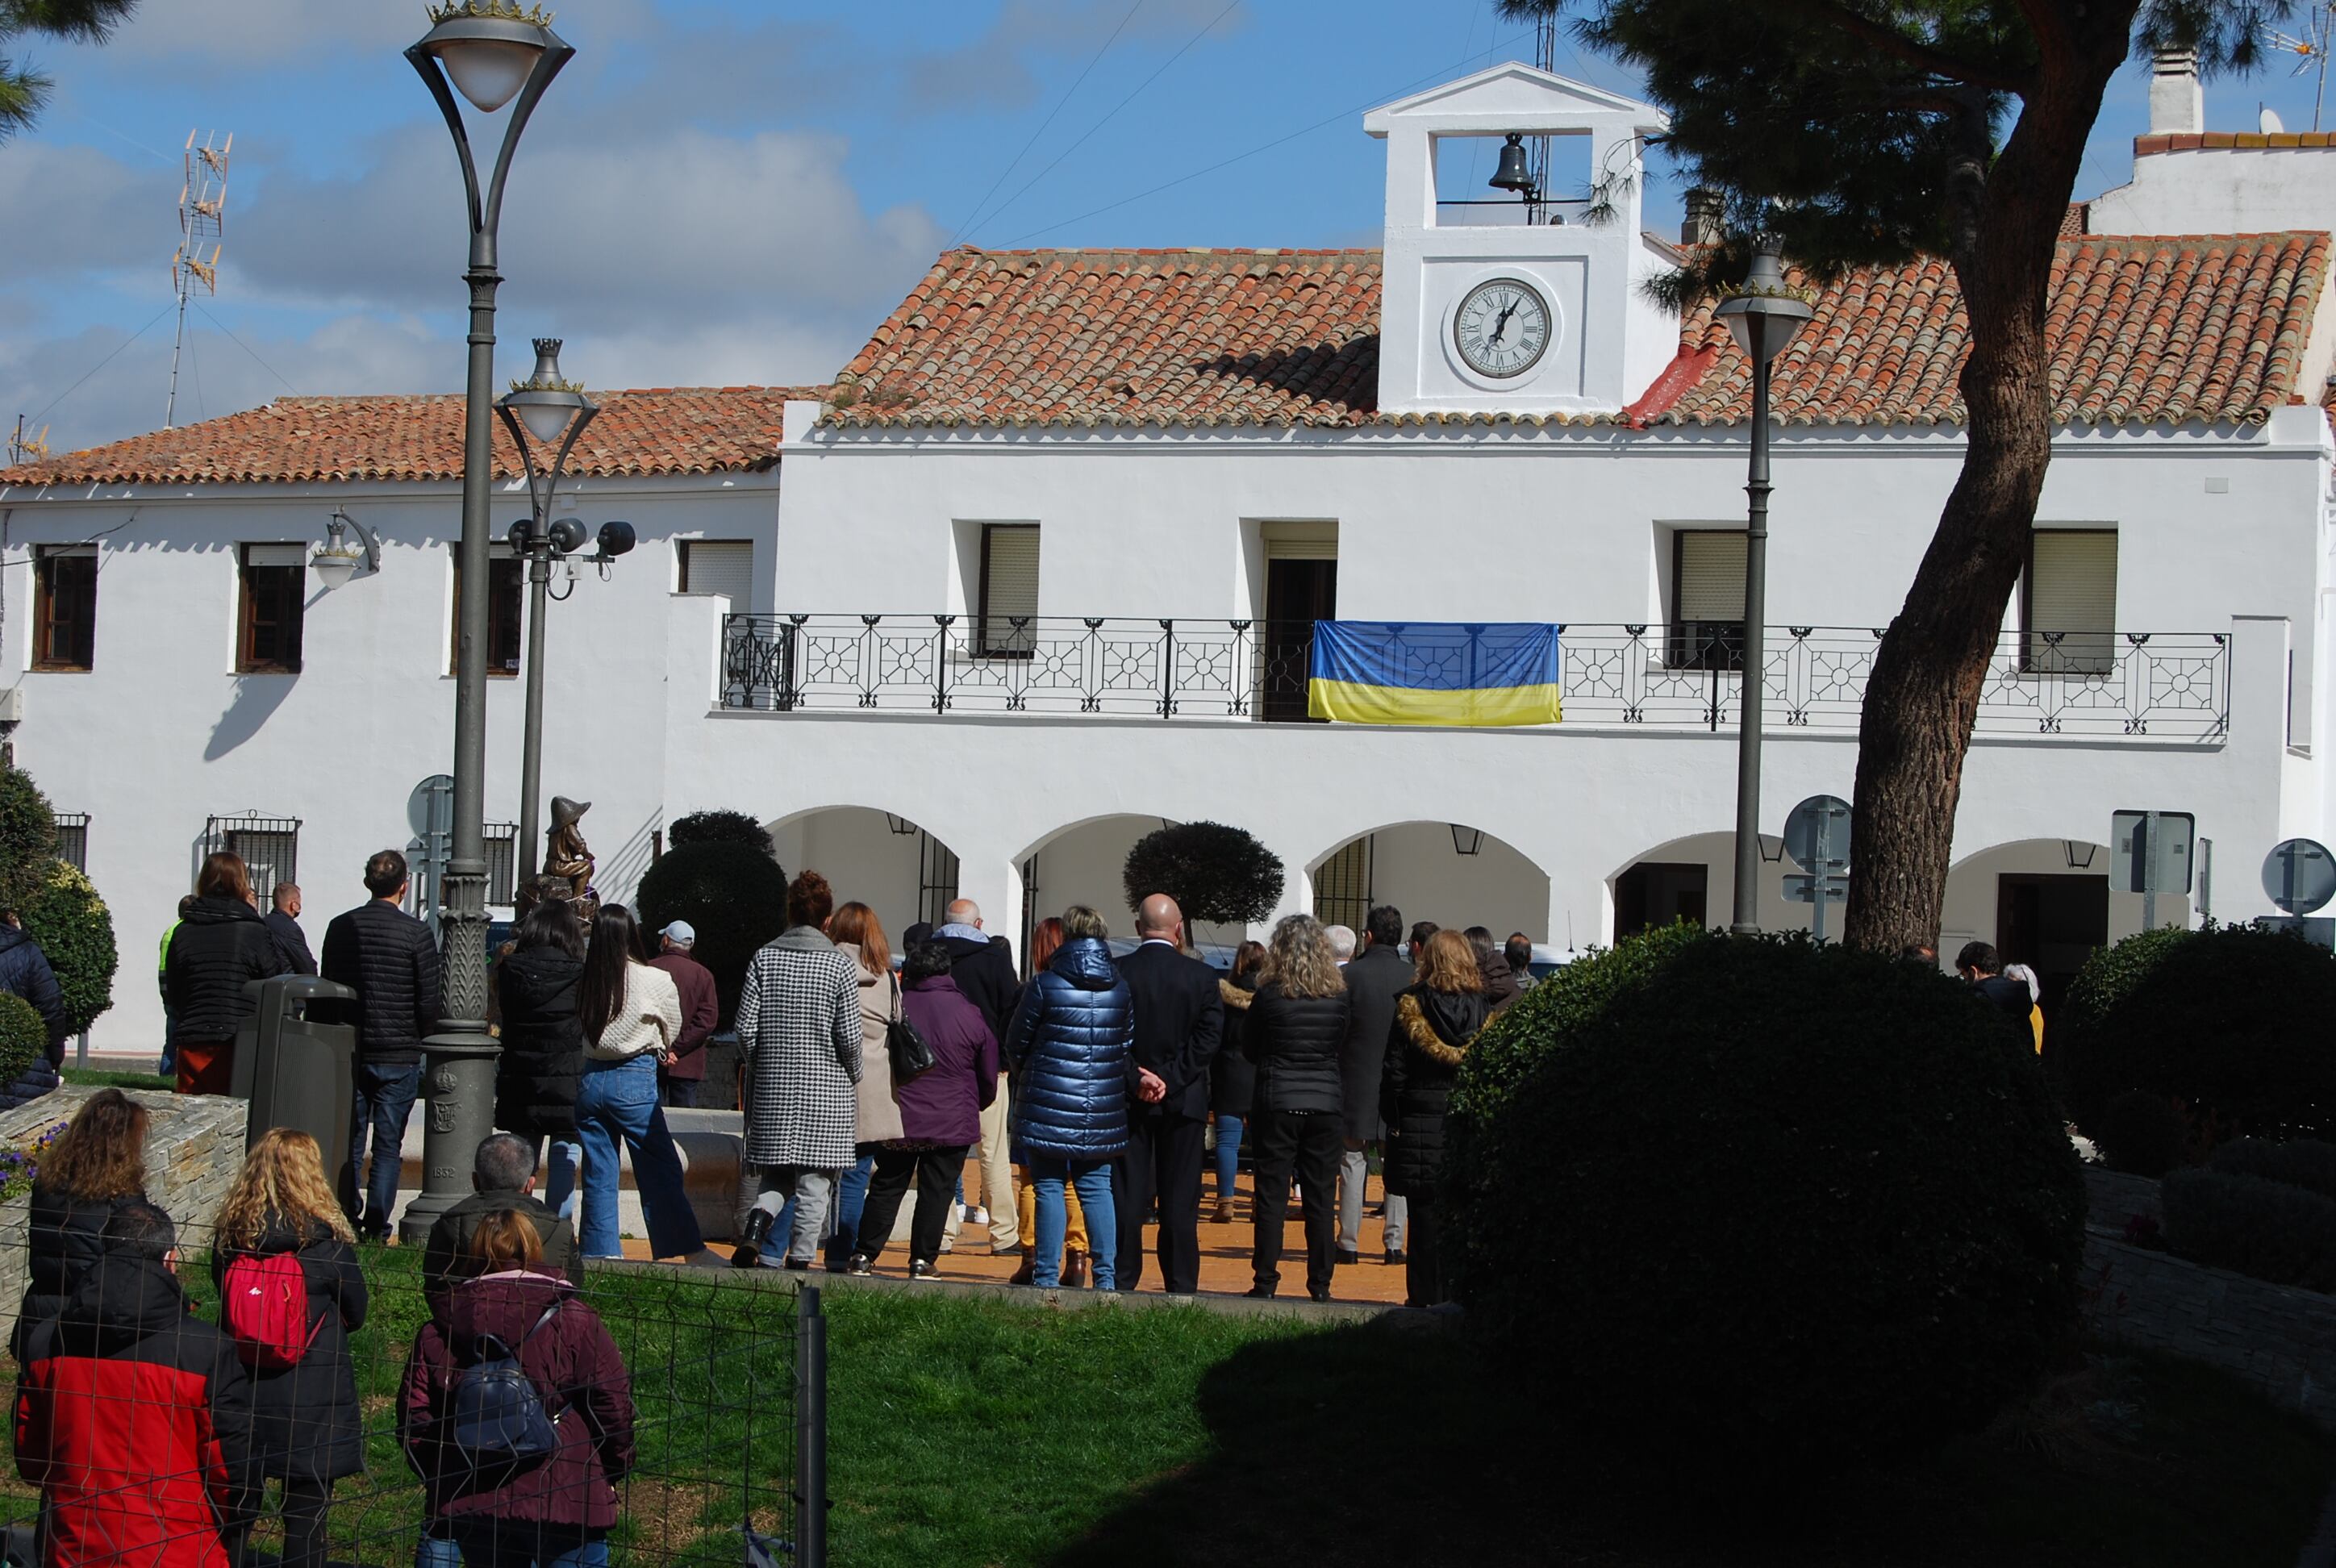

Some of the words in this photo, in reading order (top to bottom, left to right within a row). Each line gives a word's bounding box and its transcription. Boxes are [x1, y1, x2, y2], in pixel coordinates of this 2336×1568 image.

[1483, 296, 1495, 310] XI
[1498, 293, 1509, 306] XII
[1472, 310, 1483, 319] X
[1522, 310, 1534, 319] II
[1466, 324, 1479, 332] IX
[1468, 336, 1482, 352] VIII
[1496, 352, 1504, 366] VI
[1512, 351, 1520, 361] V
